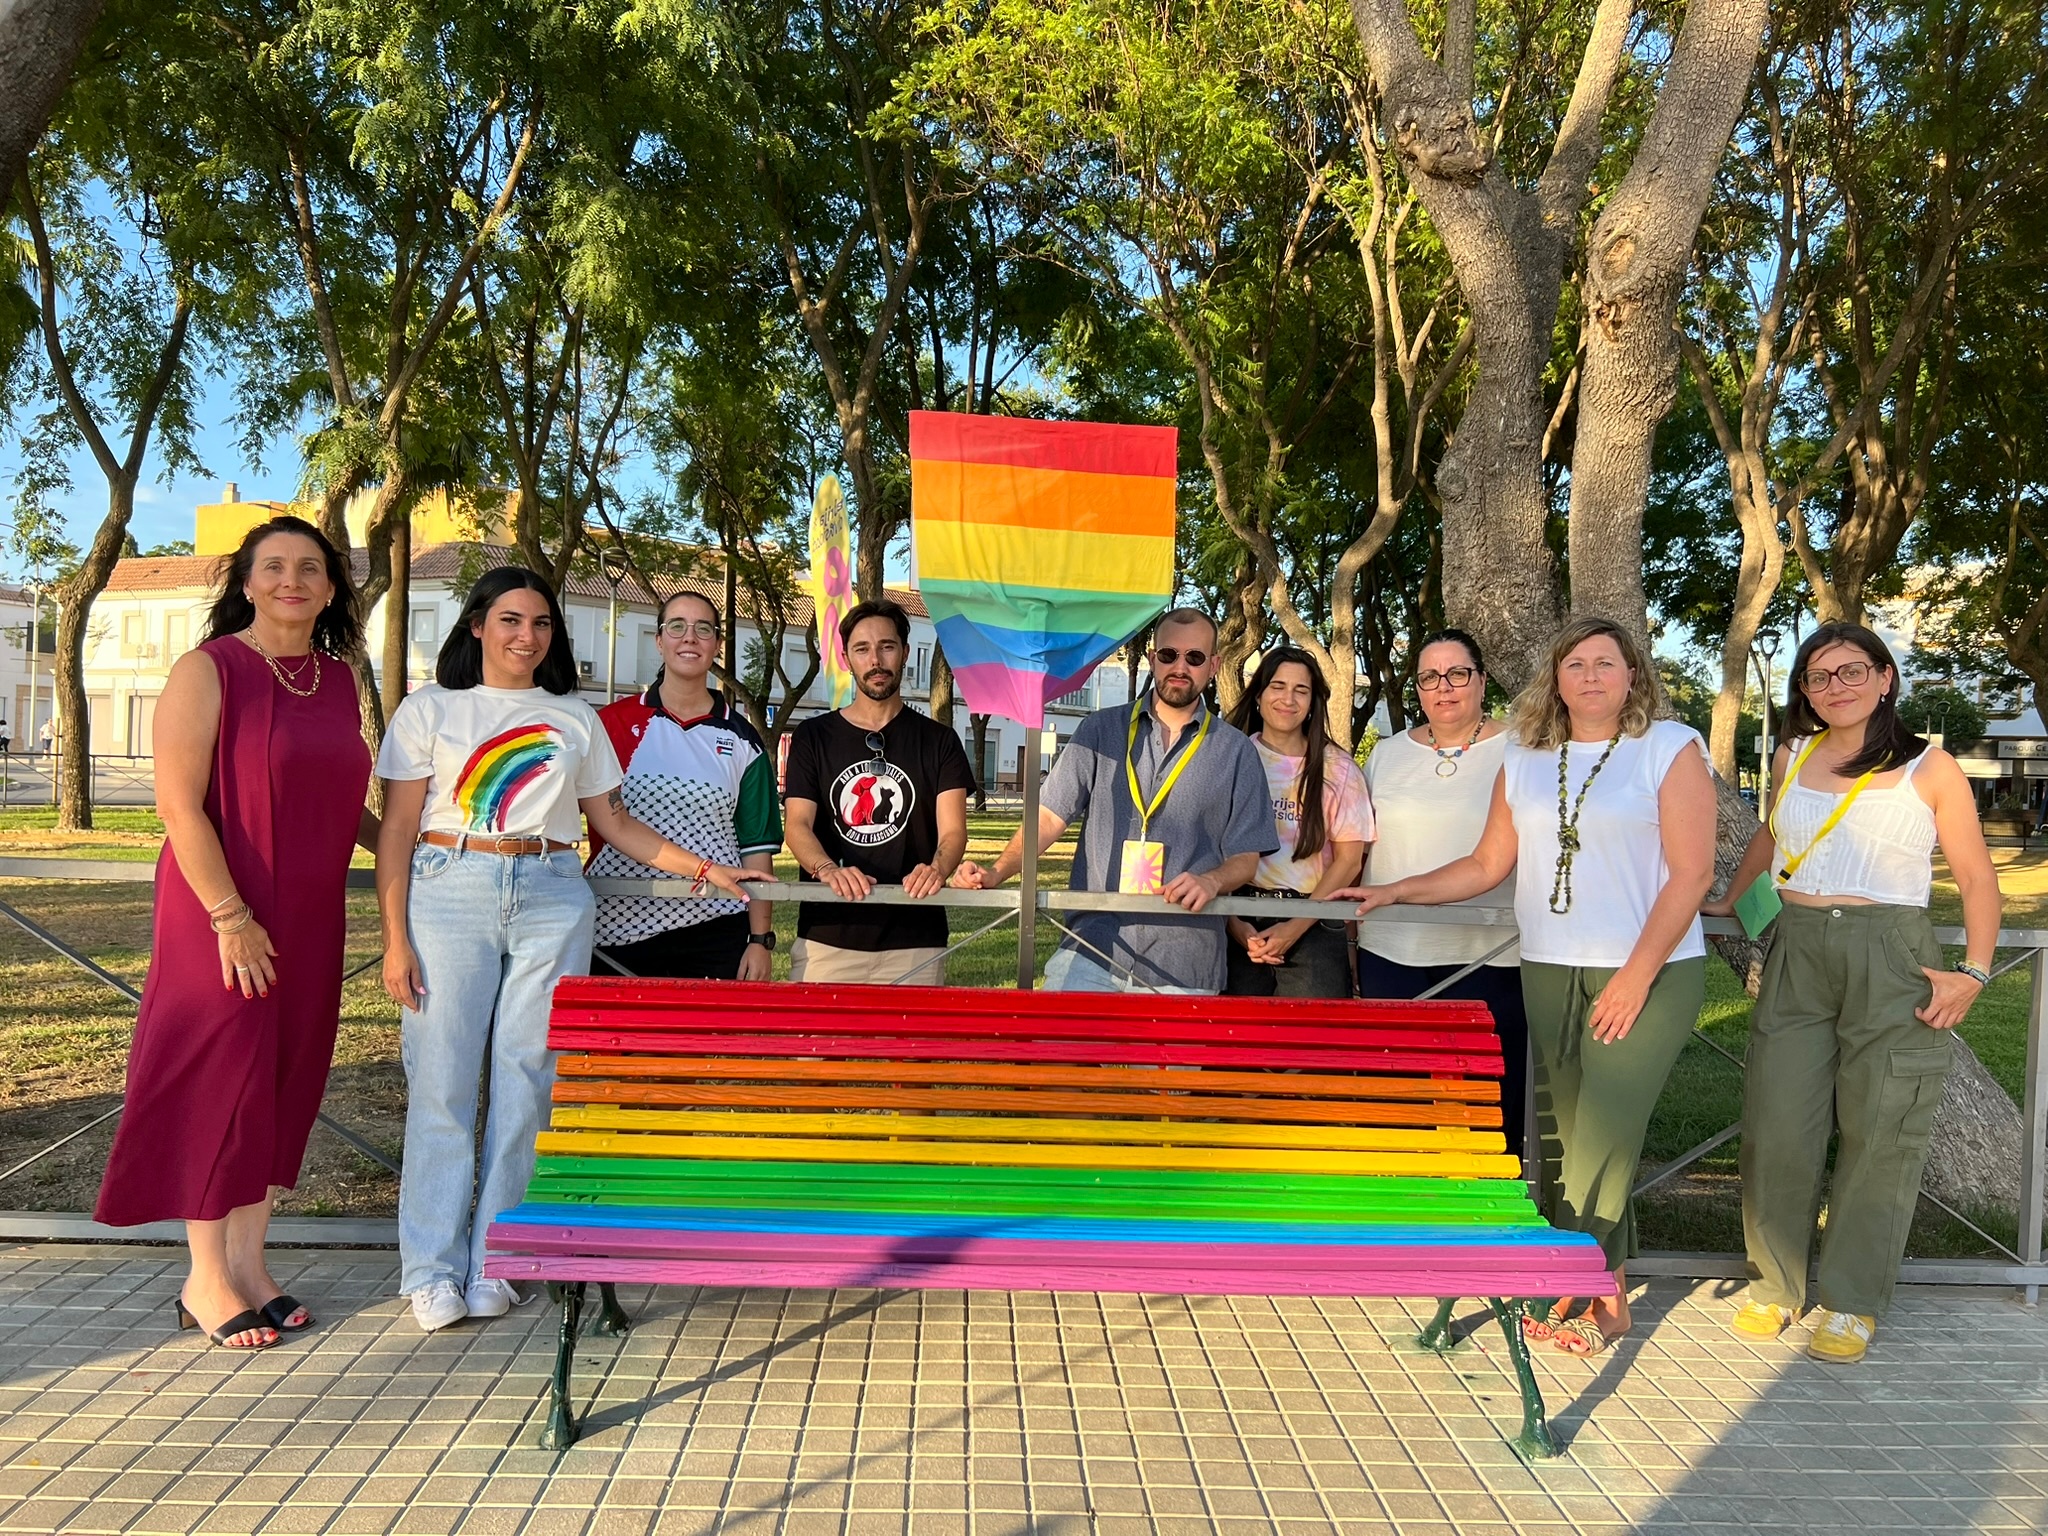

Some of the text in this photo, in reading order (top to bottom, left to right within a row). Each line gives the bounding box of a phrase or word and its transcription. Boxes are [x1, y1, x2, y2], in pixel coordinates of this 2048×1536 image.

[840, 770, 854, 785] AMA
[855, 766, 860, 774] A
[861, 762, 872, 773] LO
[846, 824, 898, 843] ODIA EL FASCISMO
